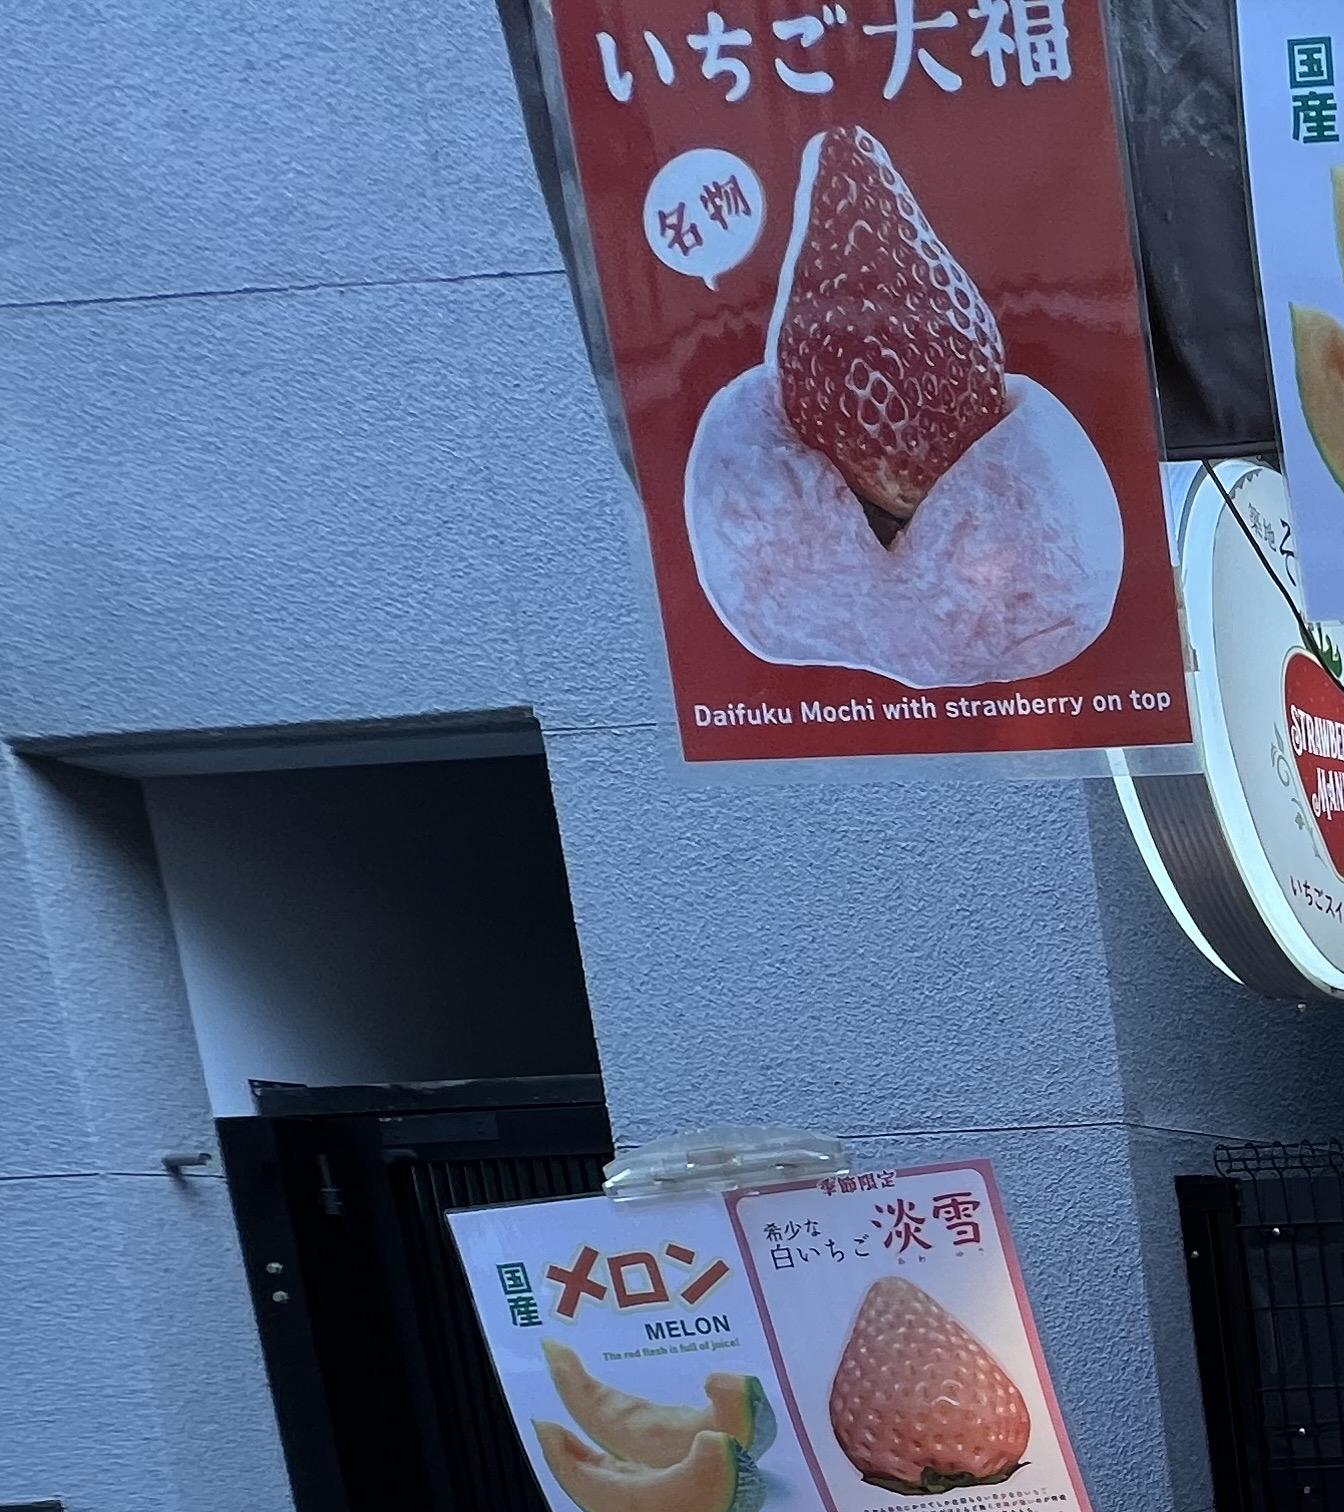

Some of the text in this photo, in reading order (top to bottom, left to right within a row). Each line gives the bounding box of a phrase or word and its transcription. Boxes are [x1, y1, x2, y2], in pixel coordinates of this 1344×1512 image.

[598, 0, 1074, 99] いちご大福
[1286, 35, 1340, 145] 国産
[656, 174, 752, 257] 名物
[695, 687, 1172, 728] Daifuku Mochi with strawberry on top
[764, 1217, 819, 1244] 希少な
[770, 1234, 870, 1271] 白いちご
[871, 1192, 981, 1253] 淡雪
[497, 1262, 543, 1328] 国産
[545, 1245, 731, 1320] メロン
[645, 1314, 731, 1341] MELON
